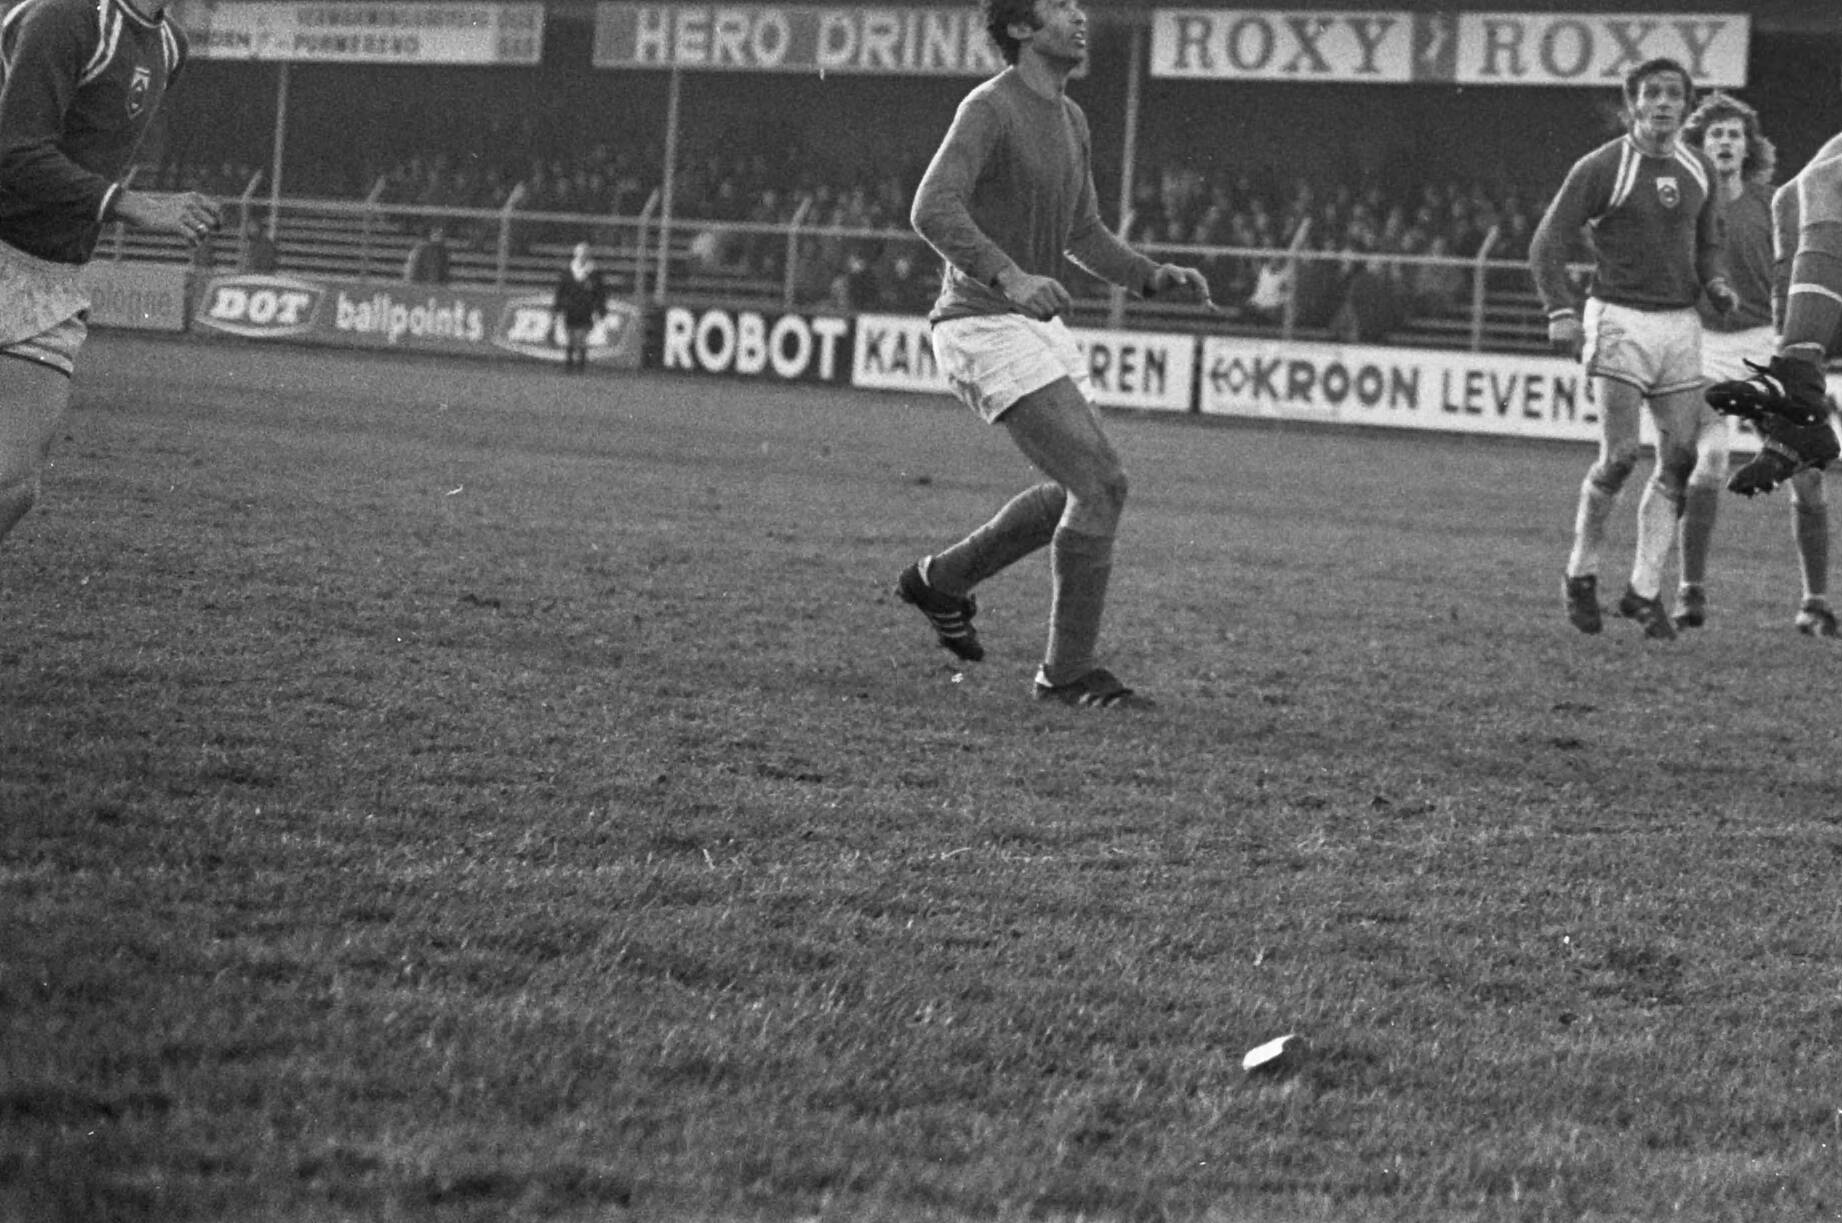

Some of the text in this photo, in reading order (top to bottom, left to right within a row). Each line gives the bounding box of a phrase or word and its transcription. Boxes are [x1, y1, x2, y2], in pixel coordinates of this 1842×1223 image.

[634, 10, 792, 66] HERO
[1177, 16, 1395, 75] ROXY
[1481, 19, 1728, 78] ROXY
[208, 287, 311, 326] DOT
[337, 290, 484, 342] ballpoints
[664, 307, 848, 378] ROBOT
[1252, 360, 1422, 412] KROON
